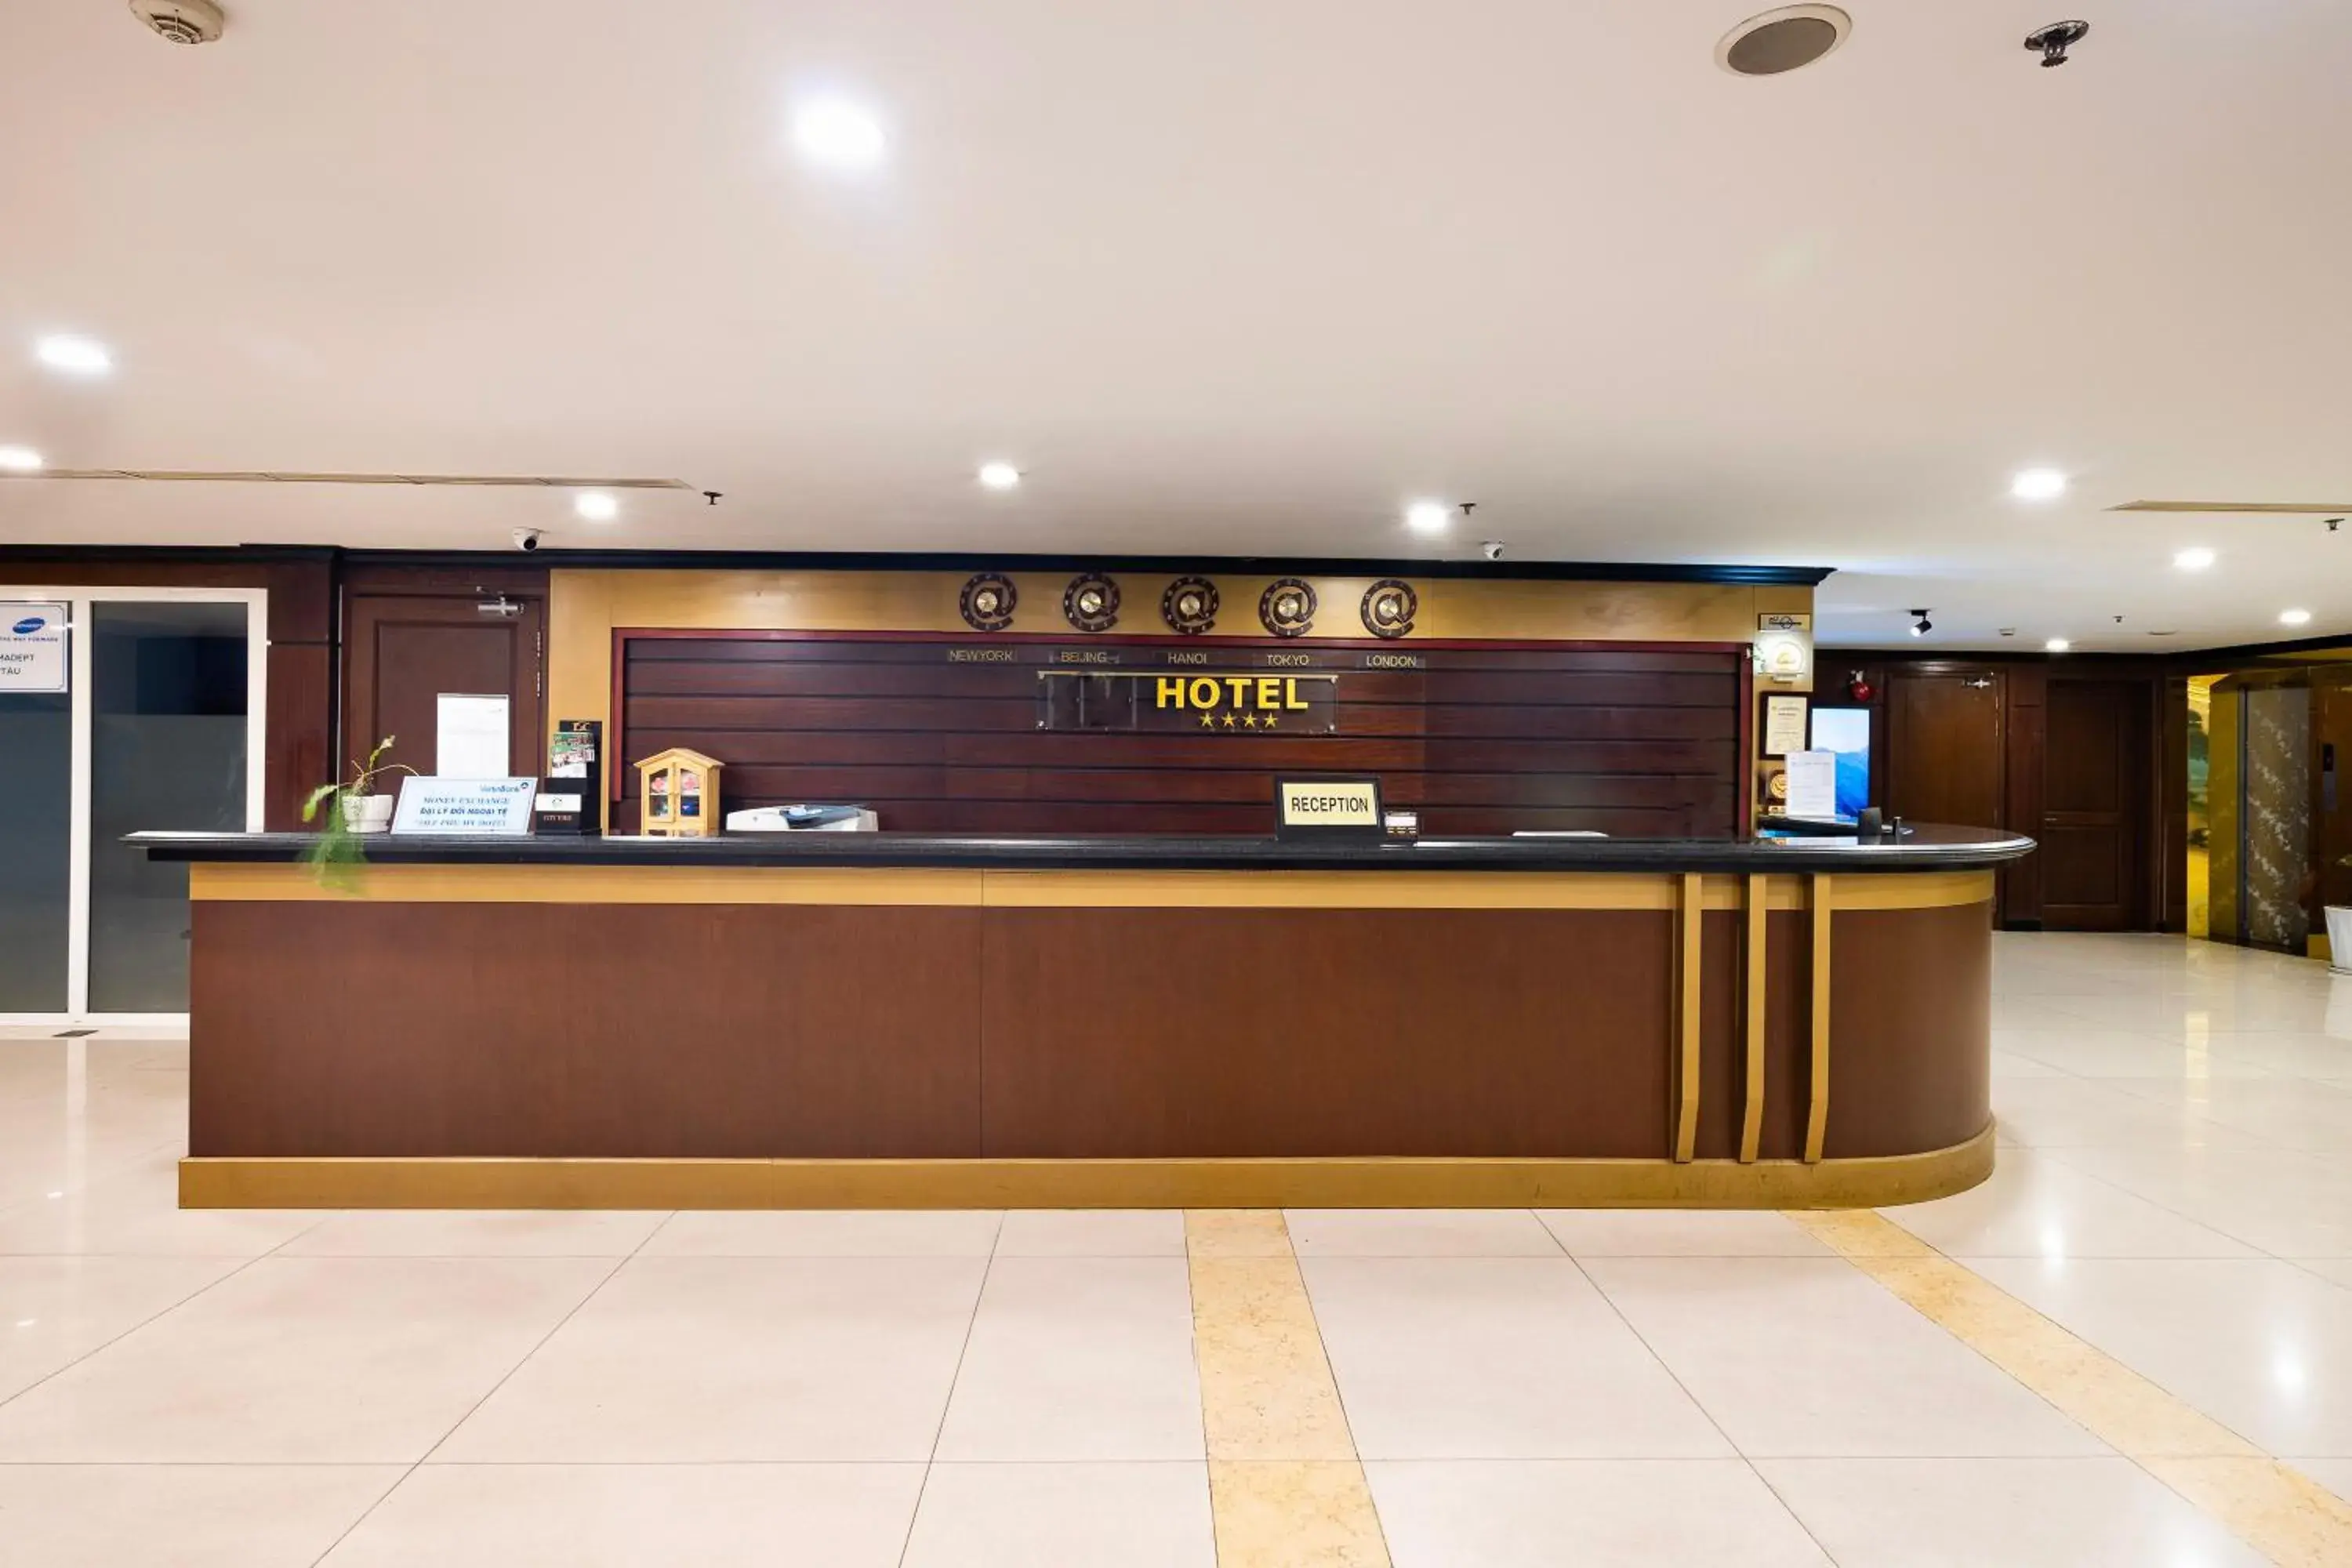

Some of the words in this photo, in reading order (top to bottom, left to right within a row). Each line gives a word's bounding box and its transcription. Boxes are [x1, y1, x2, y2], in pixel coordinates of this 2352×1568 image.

[1167, 652, 1207, 664] HANOI
[1267, 654, 1308, 666] TOKYO
[1366, 655, 1416, 666] LONDON
[1156, 677, 1308, 710] HOTEL
[1291, 797, 1368, 812] RECEPTION
